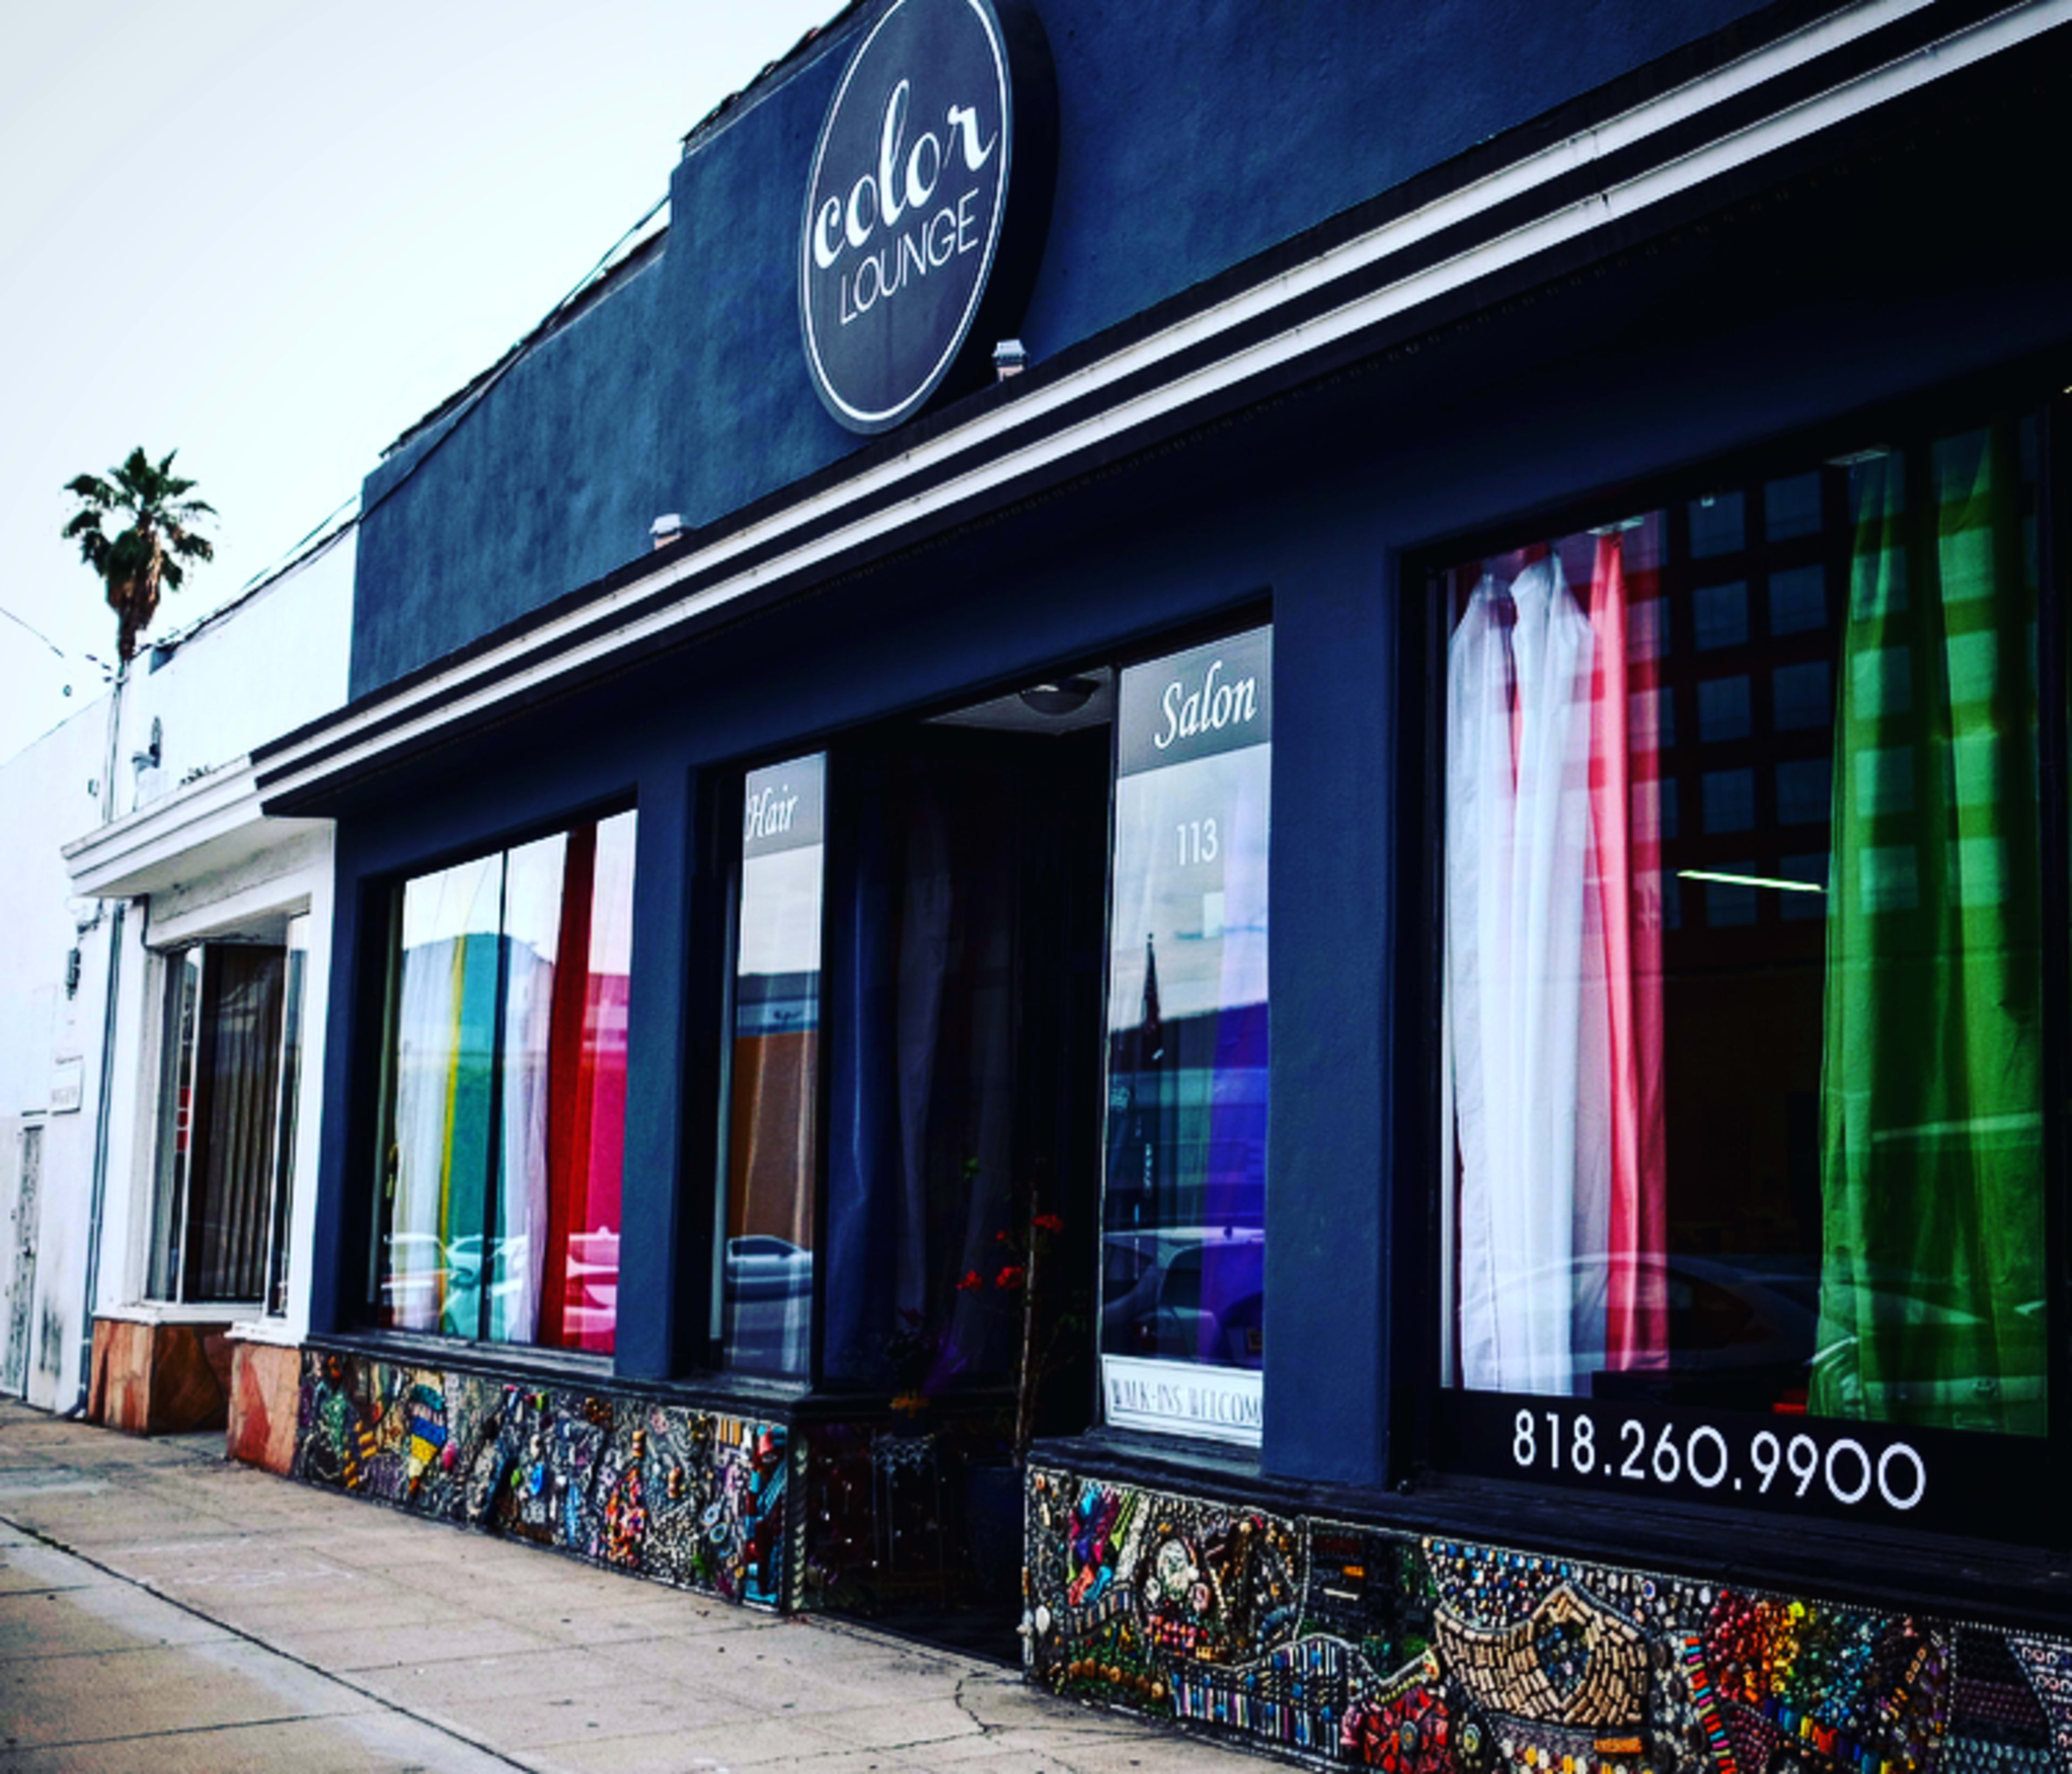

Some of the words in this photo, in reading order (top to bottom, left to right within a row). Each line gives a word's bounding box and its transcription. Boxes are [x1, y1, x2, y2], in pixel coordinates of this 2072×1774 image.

[814, 78, 998, 269] color
[841, 187, 979, 325] LOUNGE
[1154, 660, 1257, 749] Salon
[745, 784, 799, 842] Hair
[1176, 817, 1218, 866] 113
[1513, 1409, 1926, 1510] 818.260.9900
